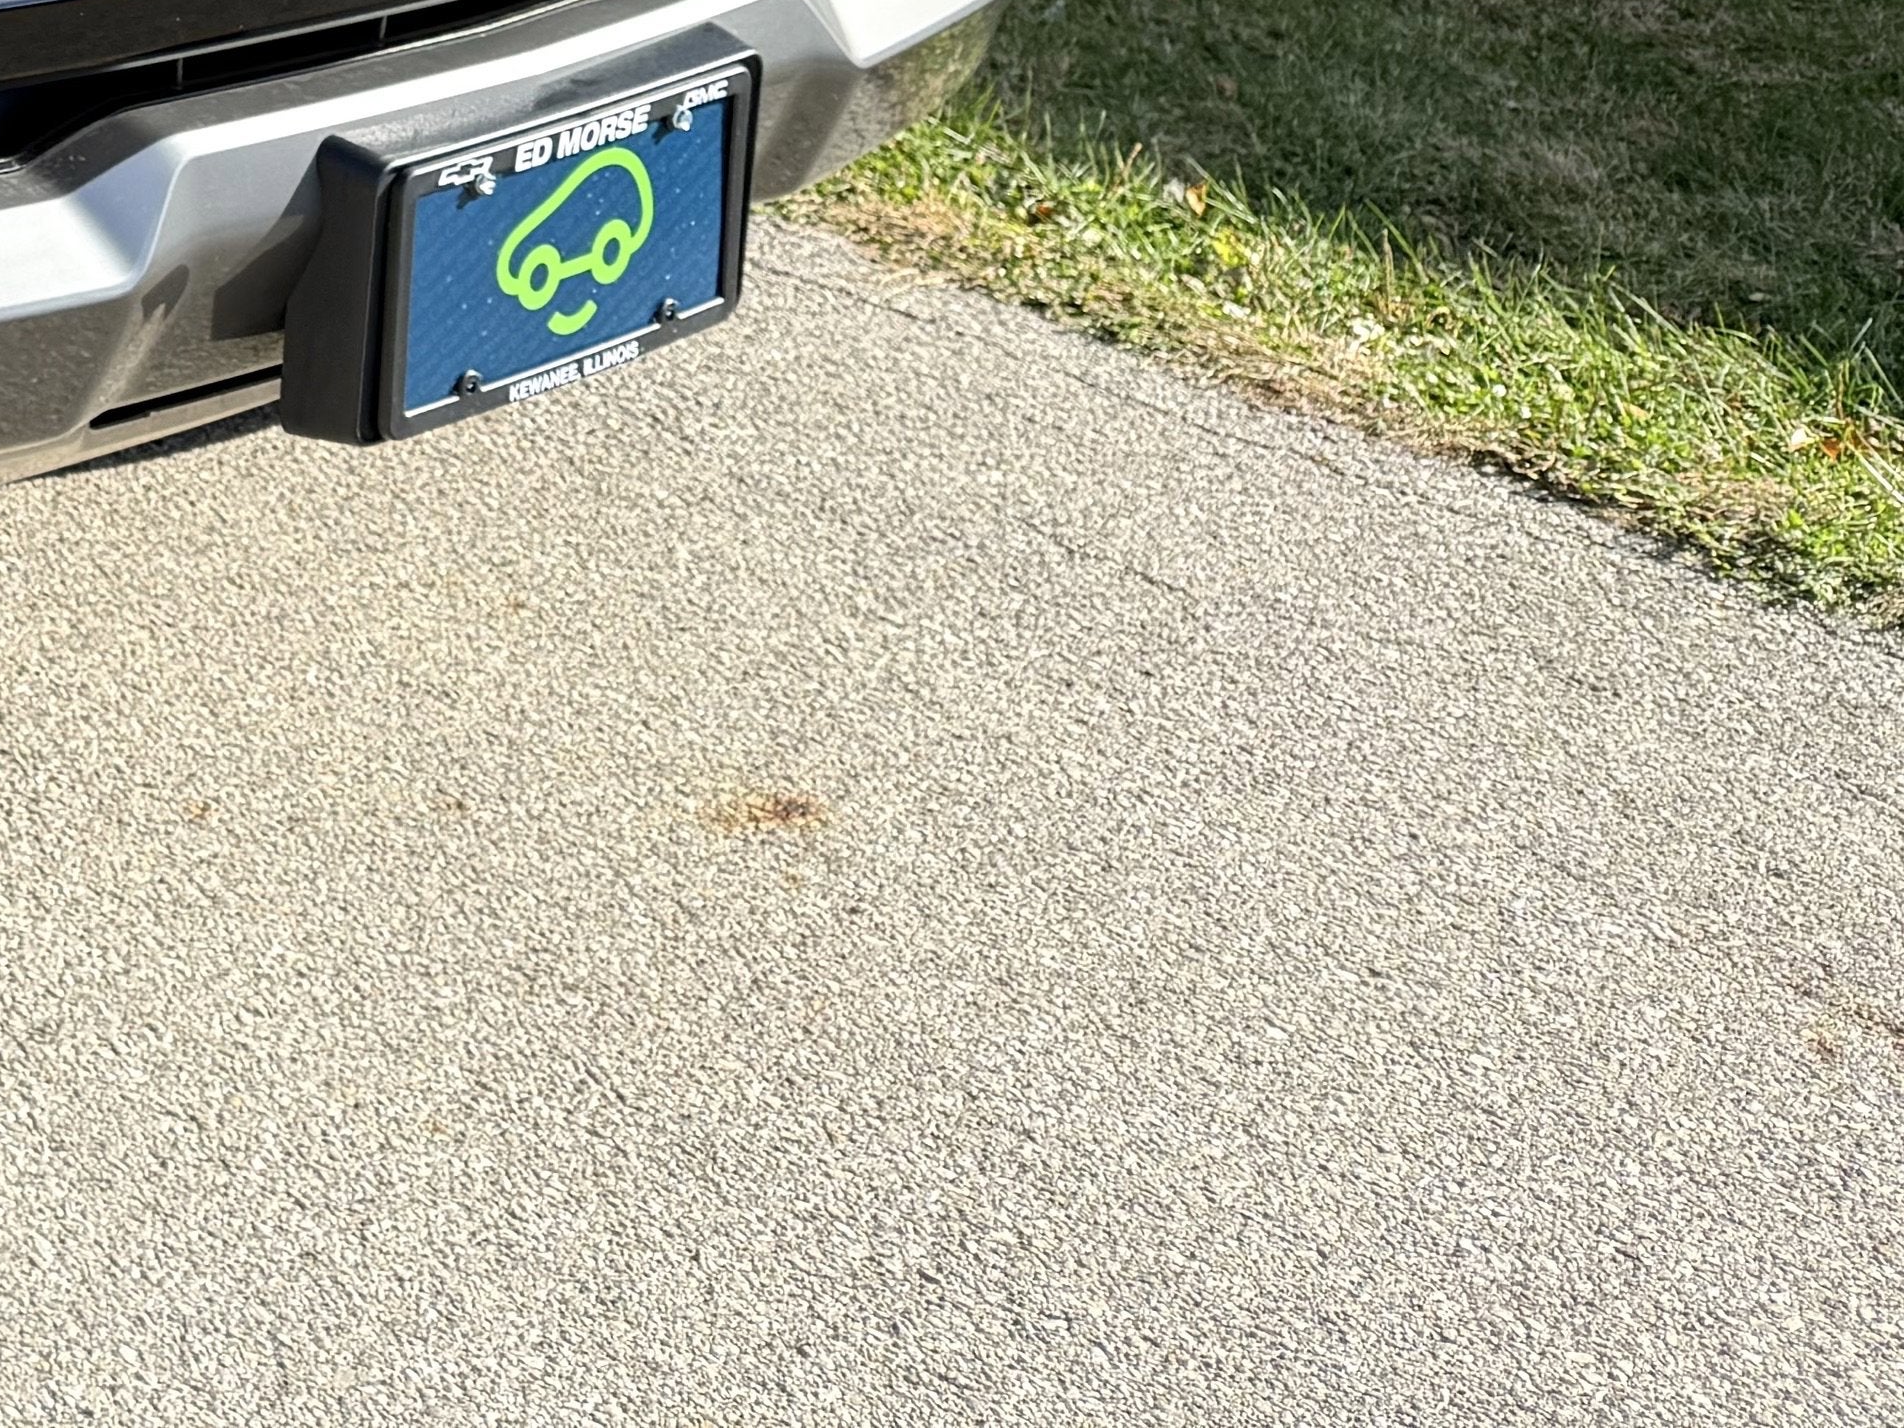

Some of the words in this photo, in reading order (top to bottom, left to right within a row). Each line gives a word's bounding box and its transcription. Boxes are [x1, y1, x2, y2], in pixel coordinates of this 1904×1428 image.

[515, 143, 552, 172] ED
[557, 104, 651, 159] MORSE
[583, 341, 639, 376] ILLINOIS
